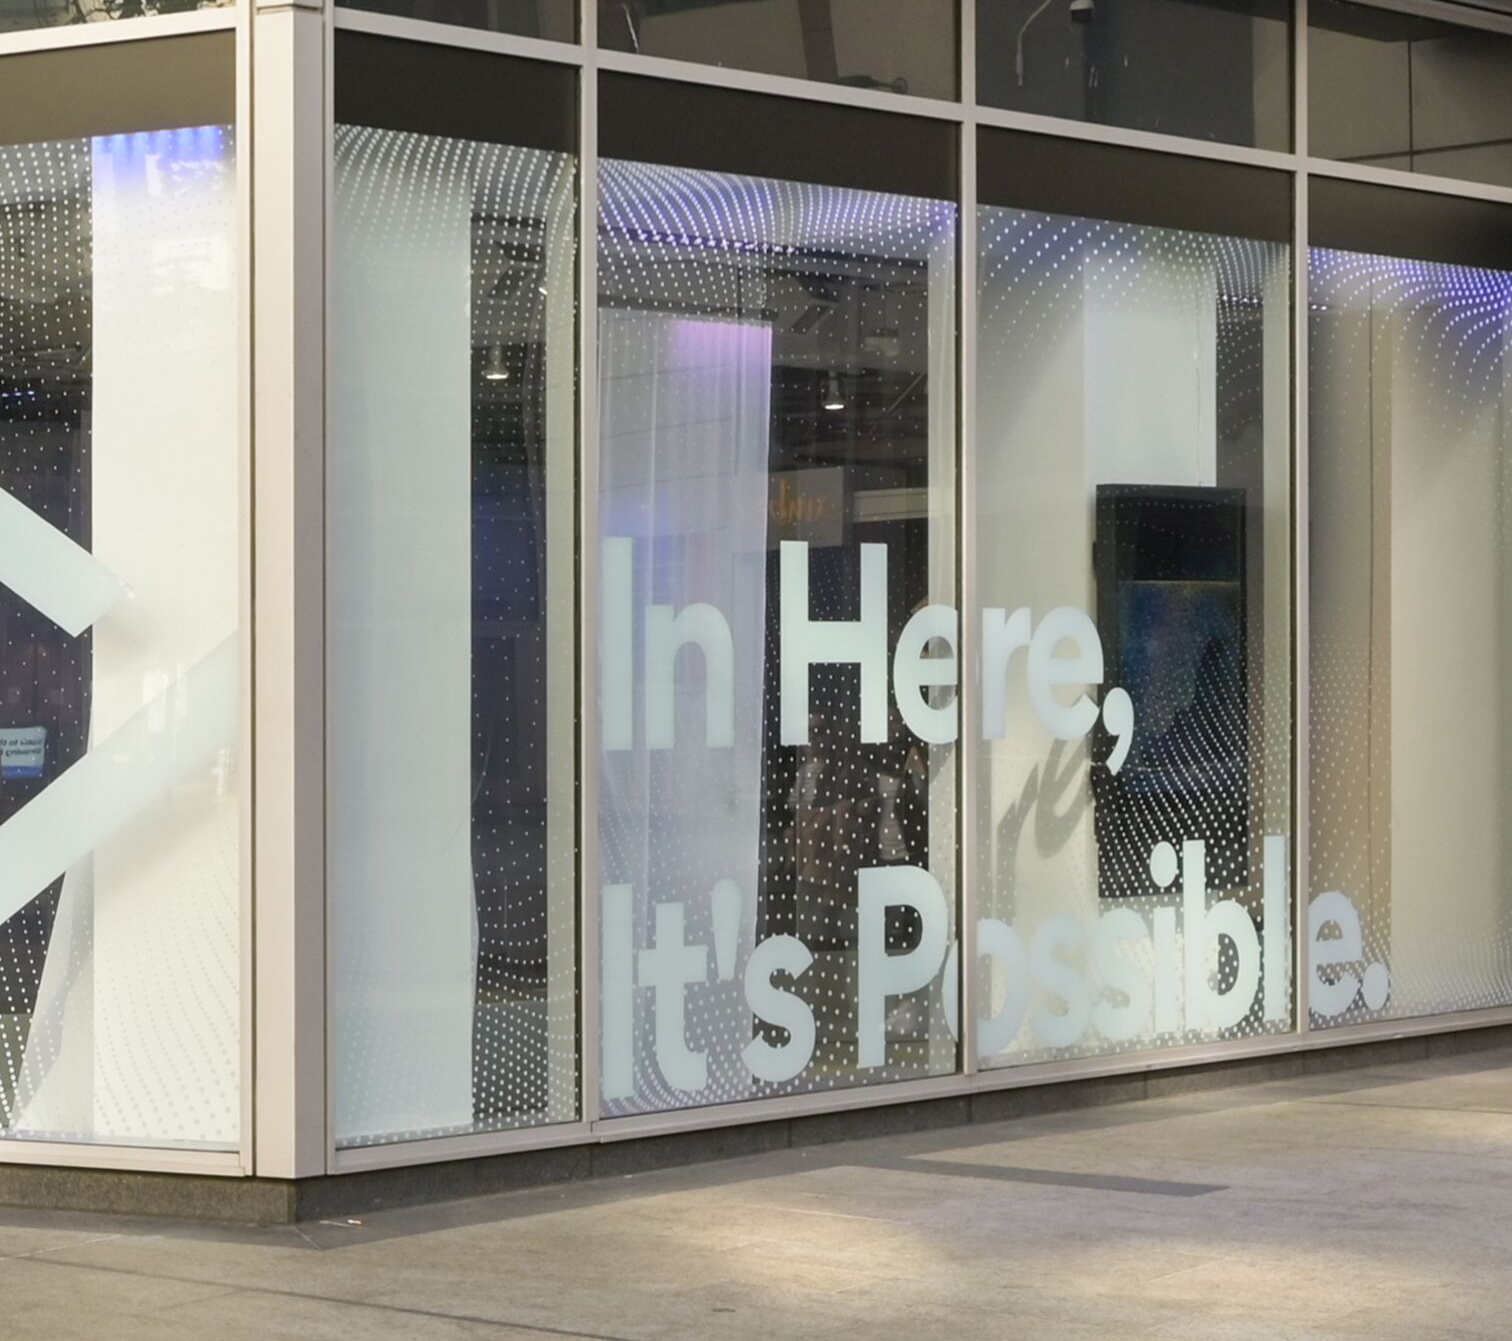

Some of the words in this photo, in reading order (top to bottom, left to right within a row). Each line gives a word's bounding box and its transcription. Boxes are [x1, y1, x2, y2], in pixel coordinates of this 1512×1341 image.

[602, 536, 735, 751] In
[780, 539, 1134, 775] Here,
[602, 878, 816, 1100] It's
[858, 835, 1392, 1070] Possible.
